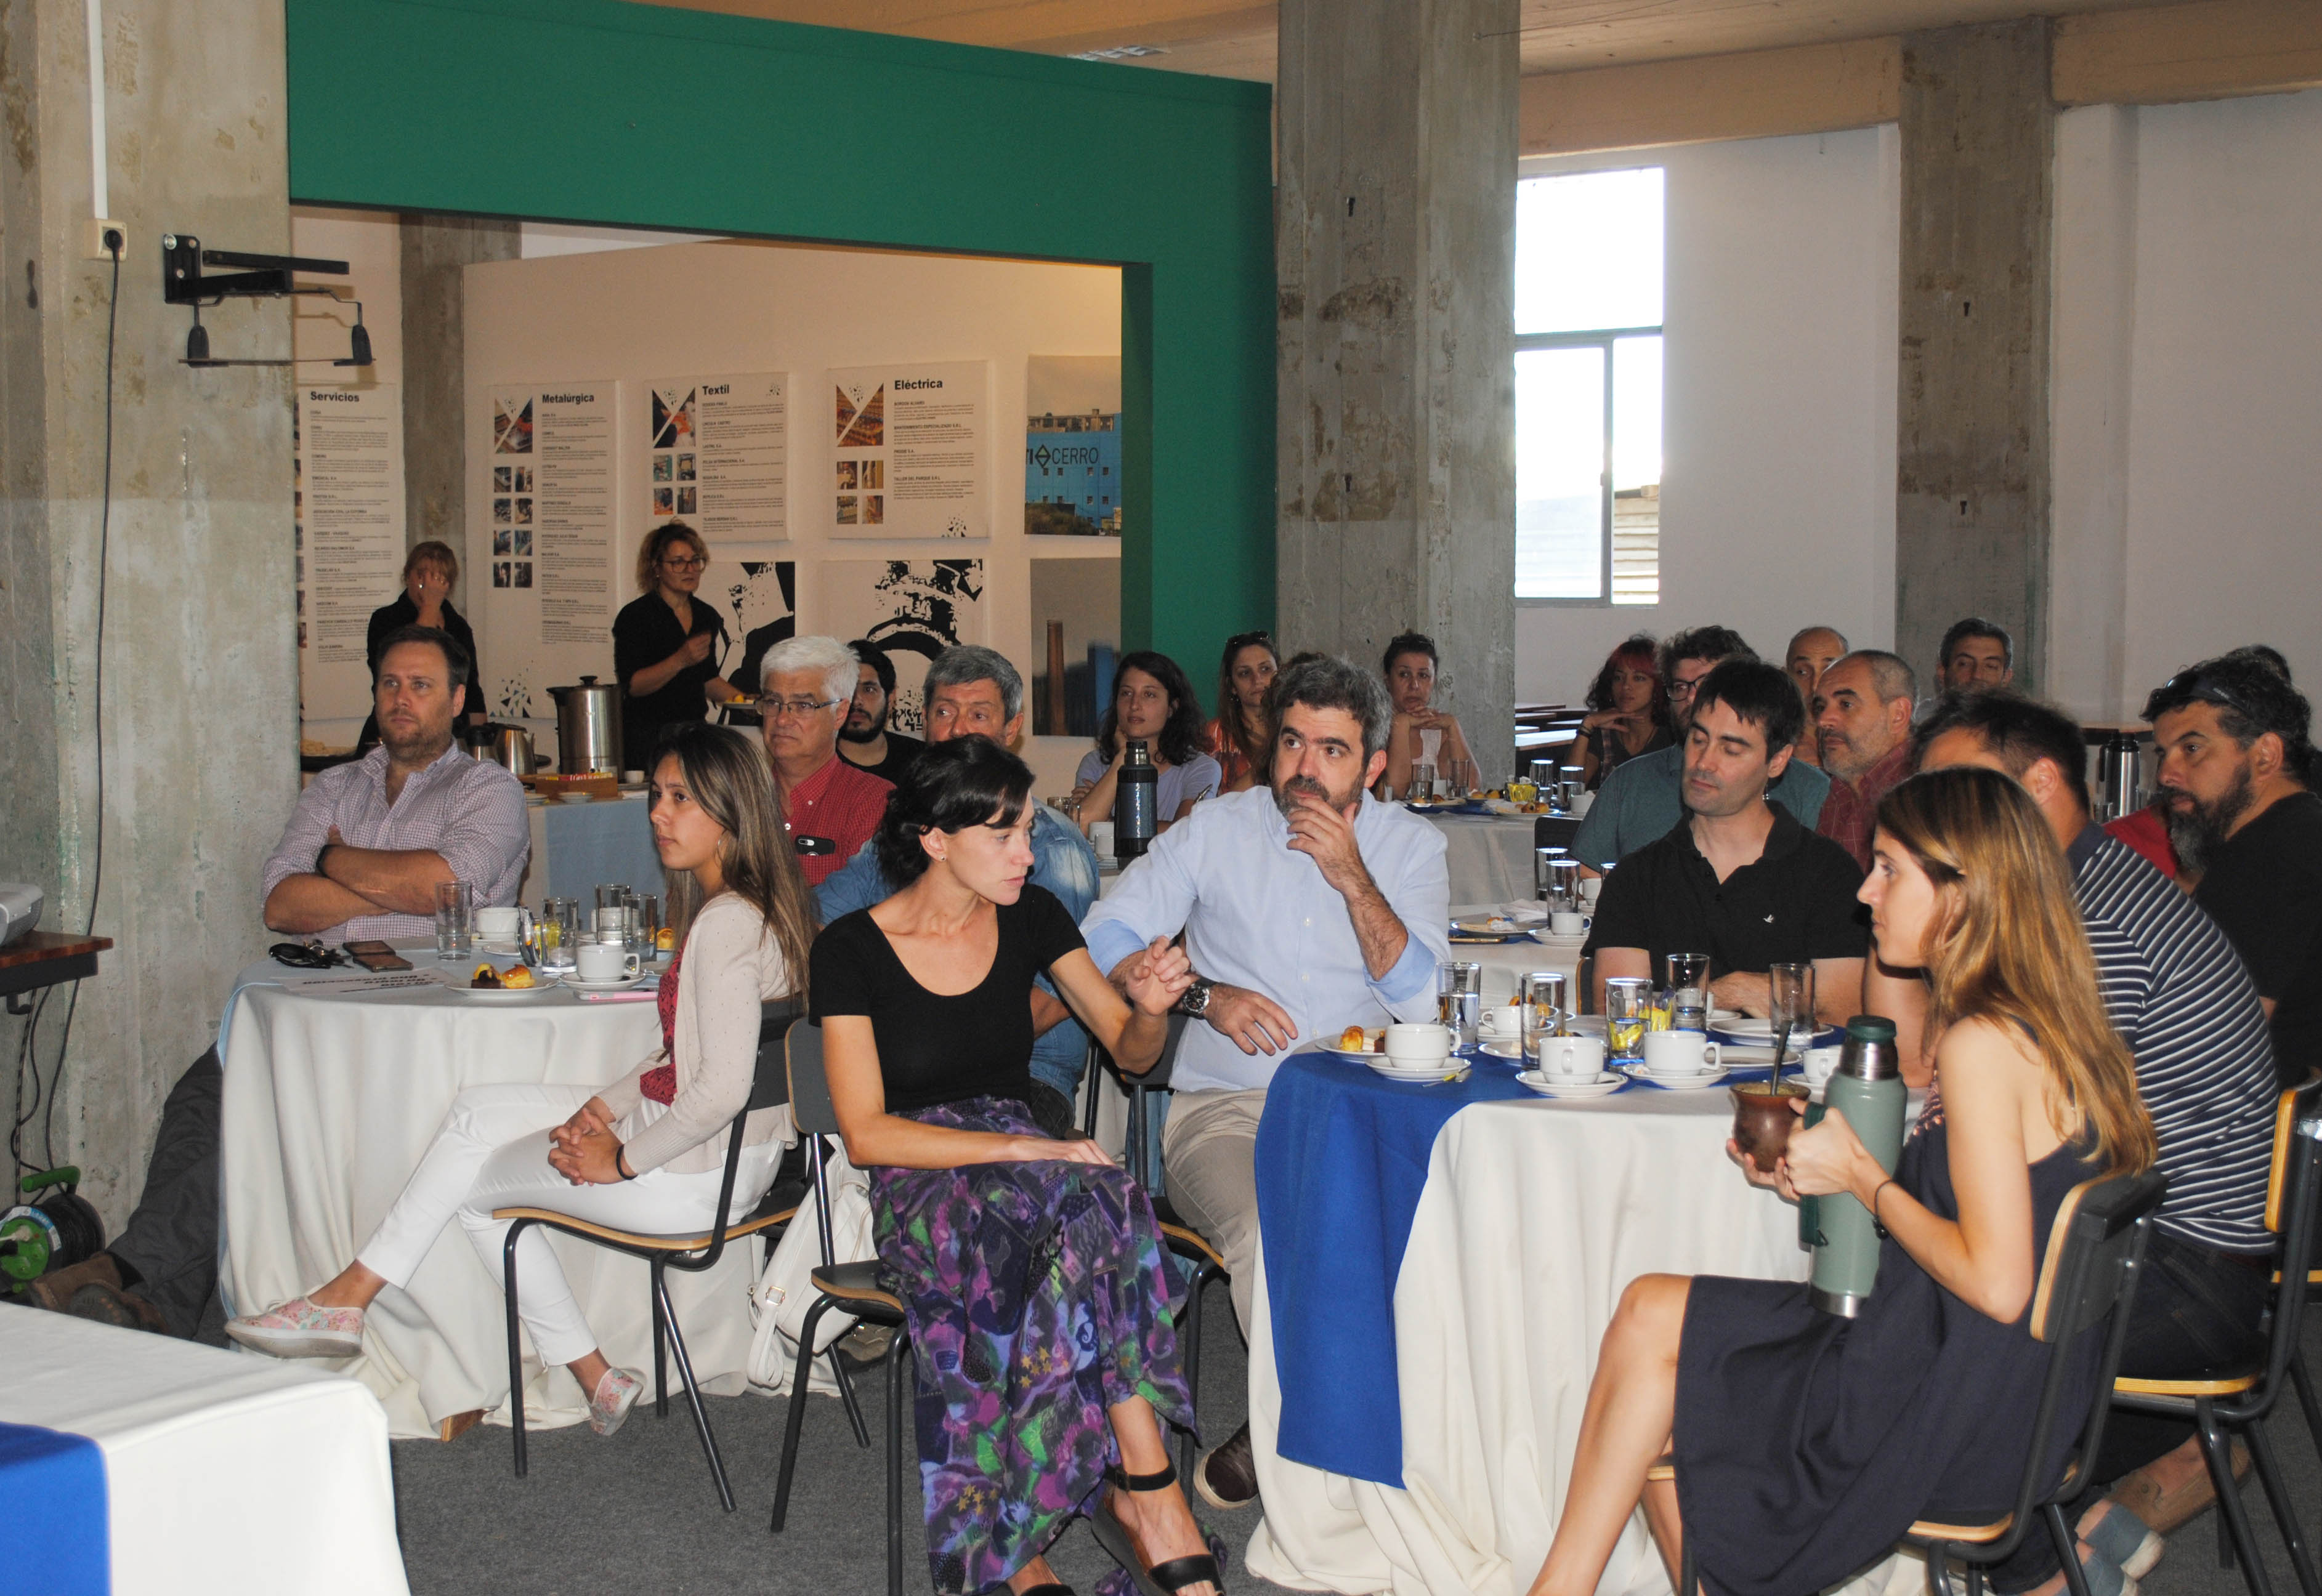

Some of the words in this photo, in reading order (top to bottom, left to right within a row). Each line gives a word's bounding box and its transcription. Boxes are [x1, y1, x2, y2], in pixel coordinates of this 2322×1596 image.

[702, 384, 730, 395] Textil
[894, 379, 943, 390] Eléctrica
[310, 391, 360, 402] Servicios
[542, 393, 594, 405] Metalúrgica
[1052, 448, 1099, 464] CERRO
